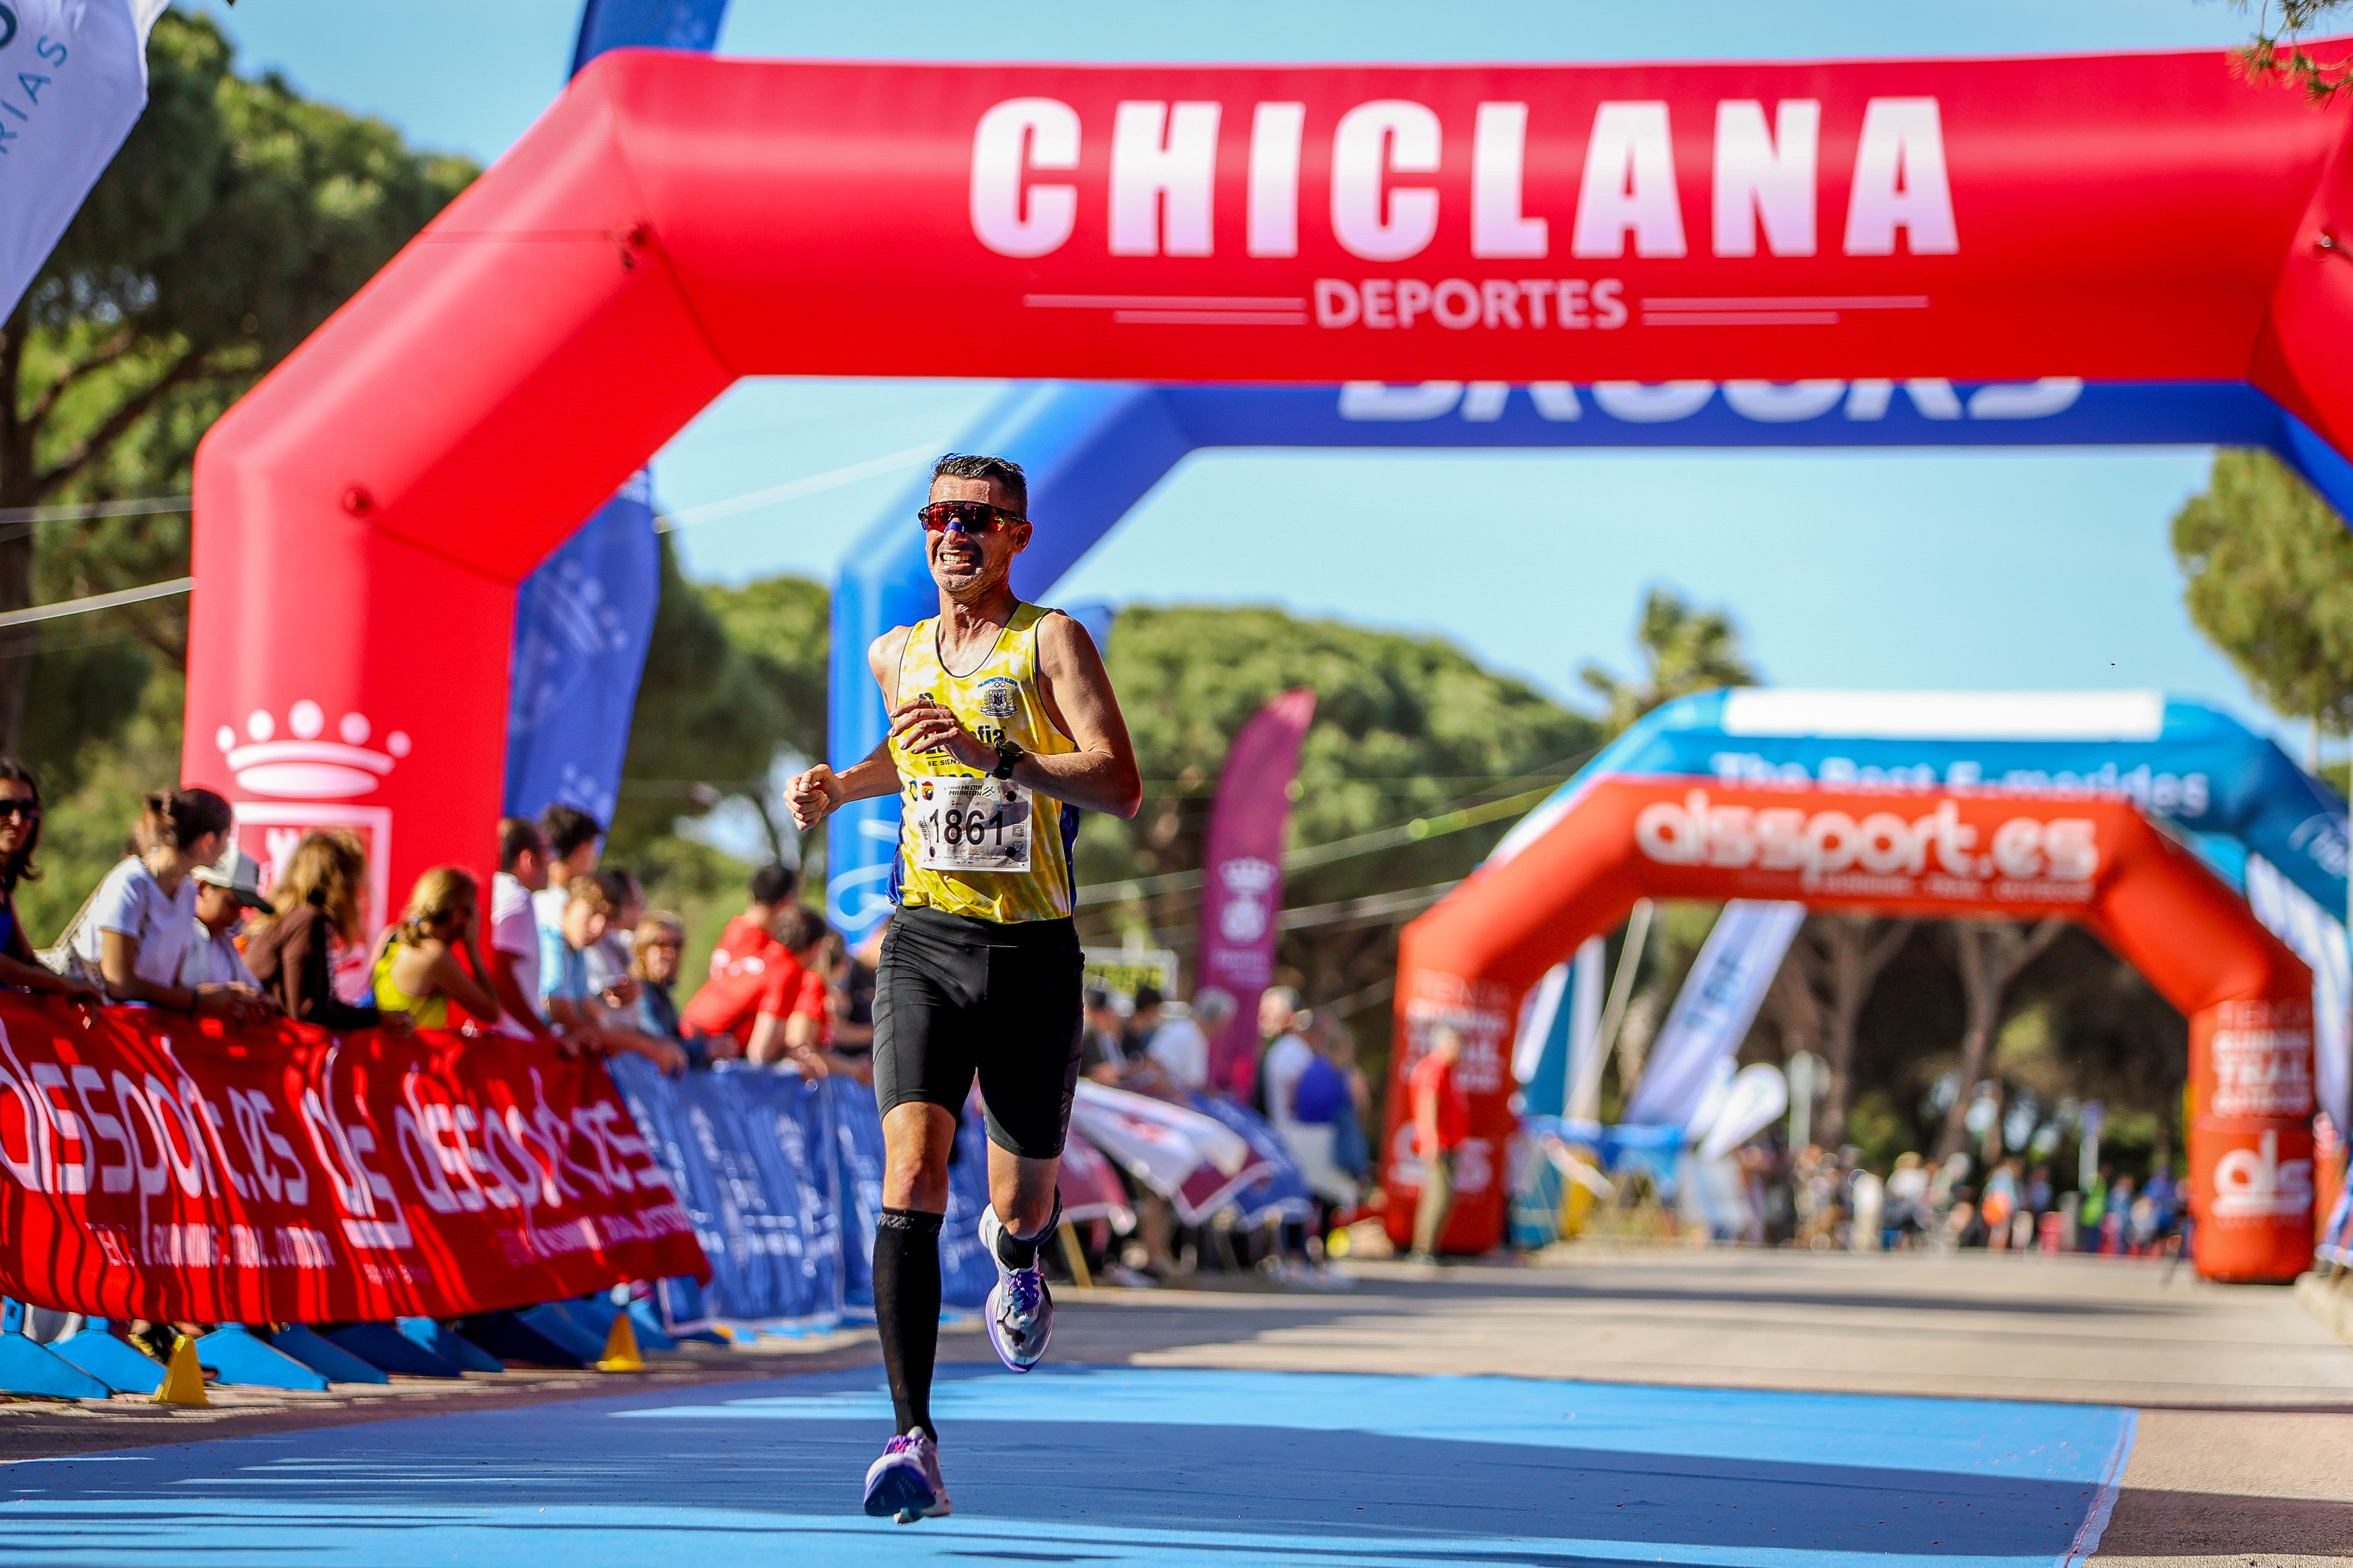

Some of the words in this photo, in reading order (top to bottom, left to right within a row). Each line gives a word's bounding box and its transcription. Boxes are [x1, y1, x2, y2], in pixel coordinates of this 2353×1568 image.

[969, 96, 1960, 262] CHICLANA
[1314, 276, 1629, 332] DEPORTES
[929, 809, 1003, 846] 1861
[1634, 788, 2099, 892] alssport.es
